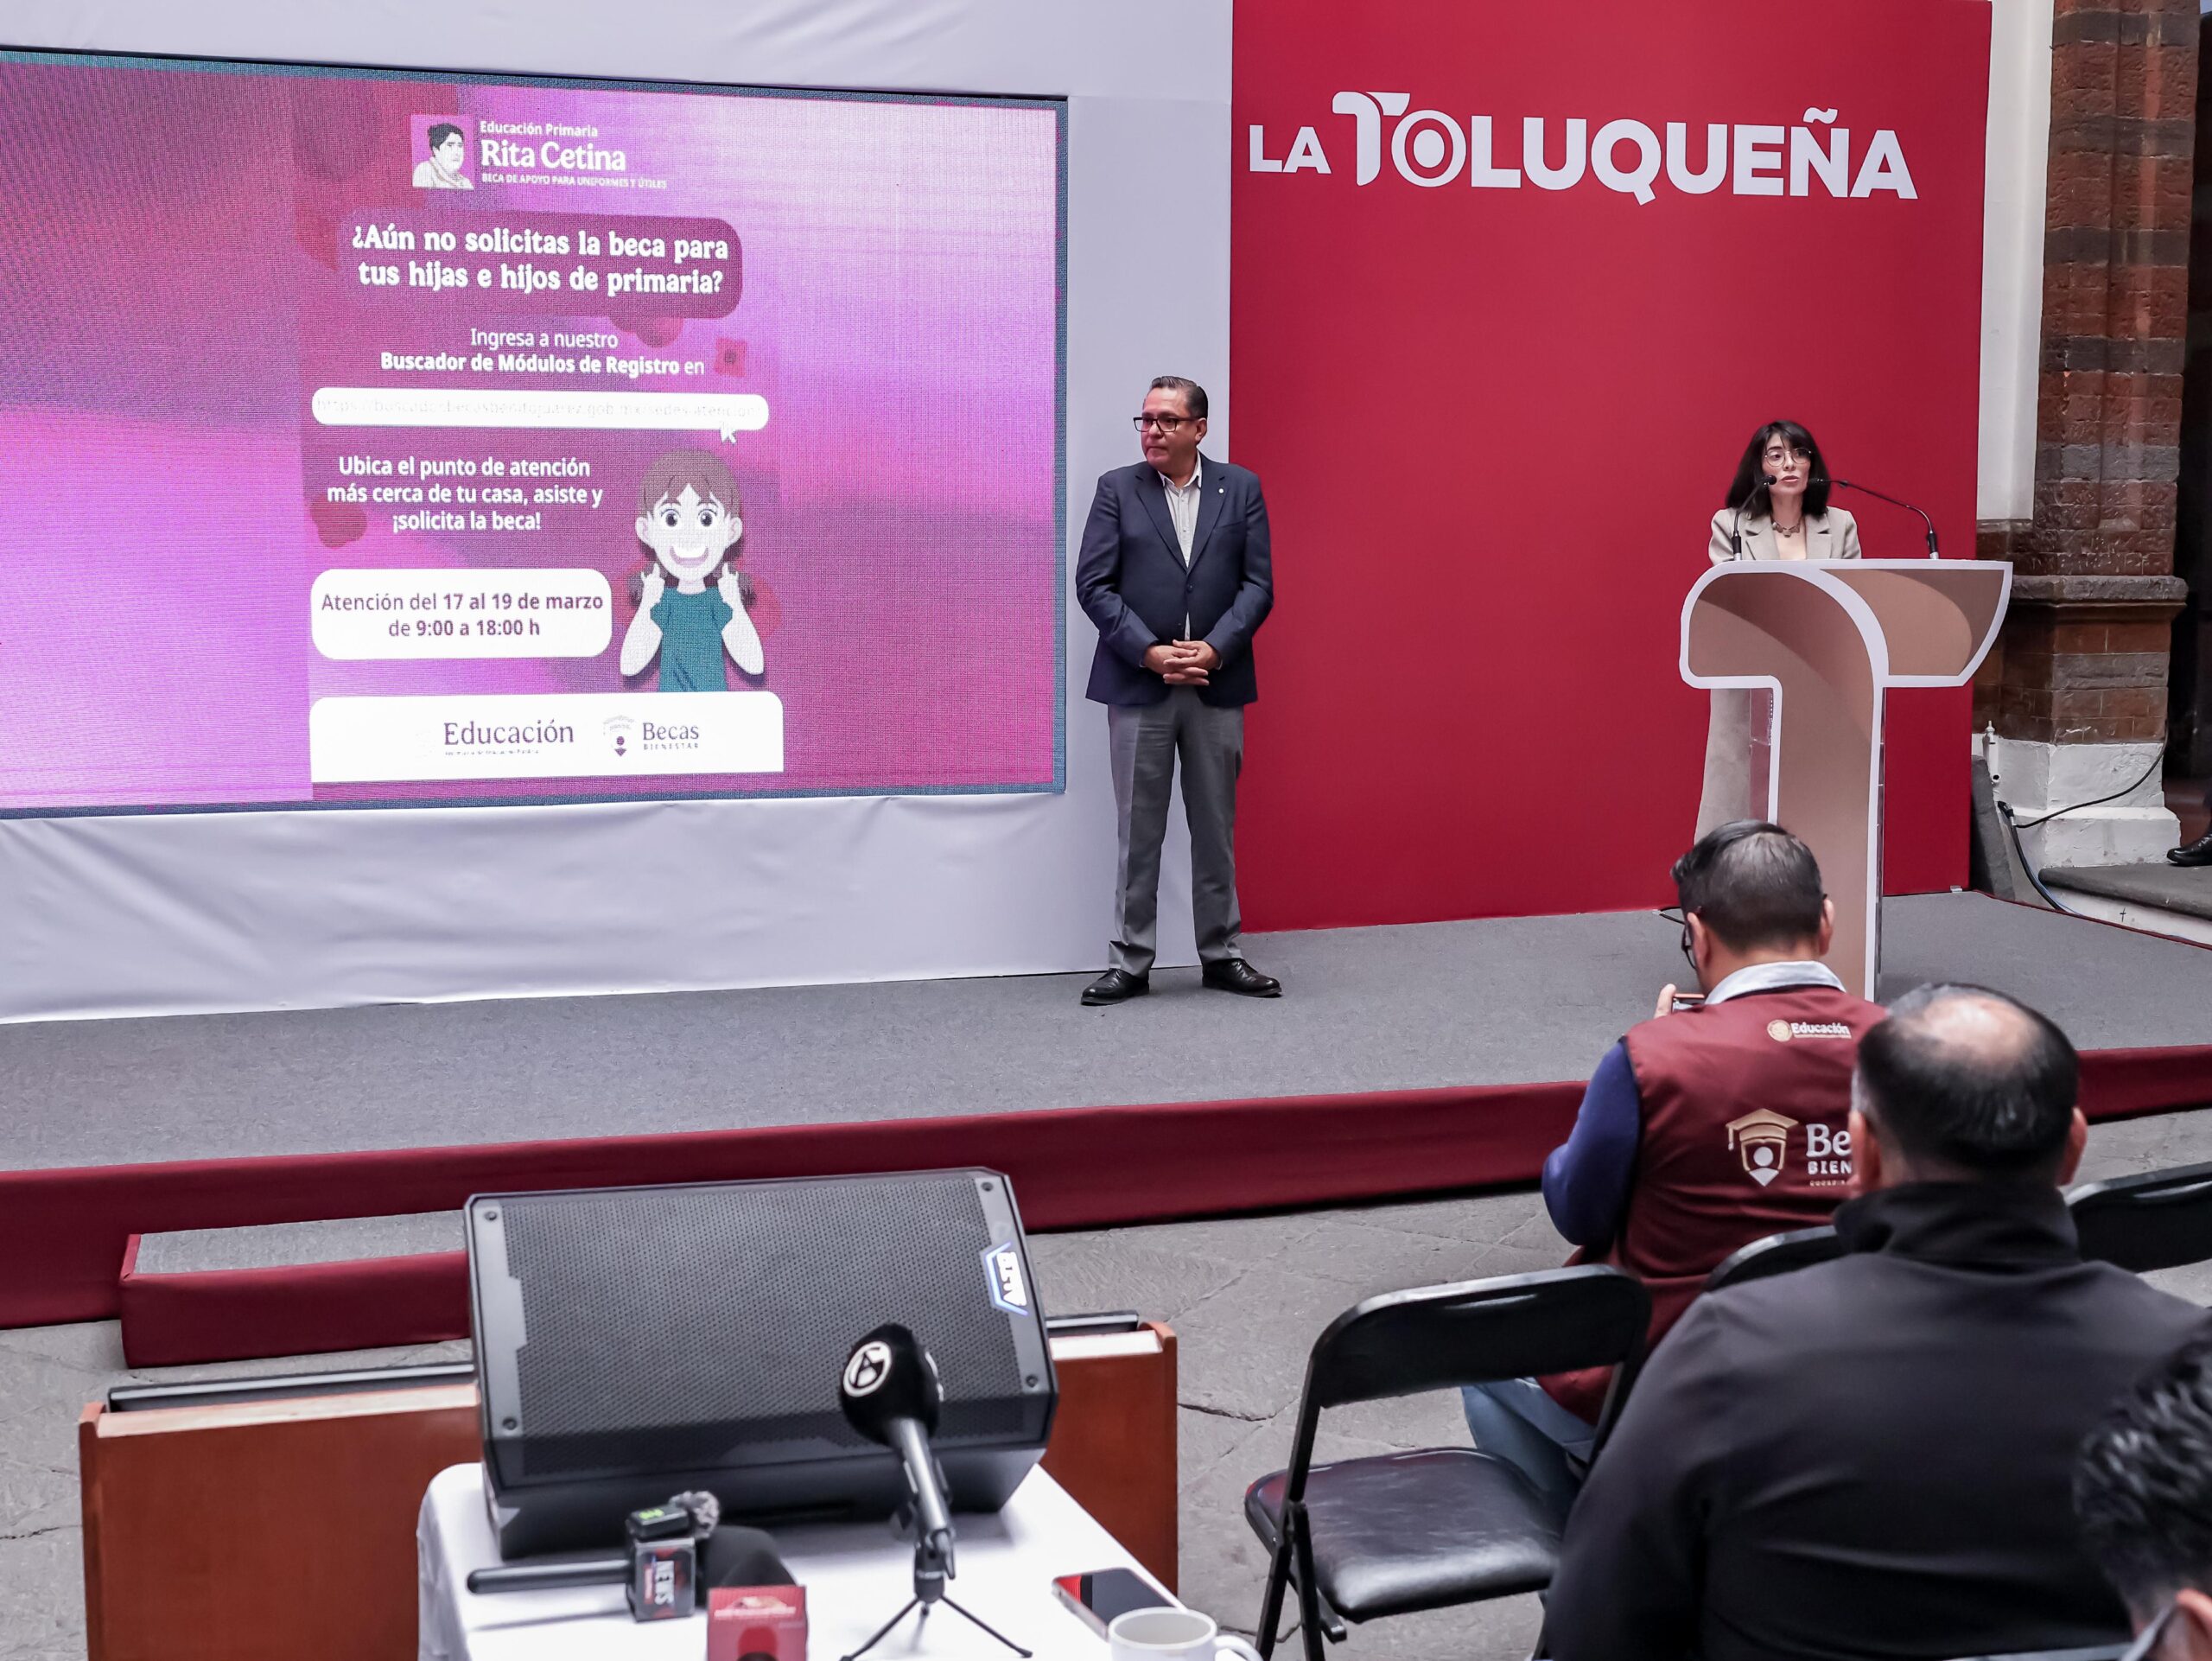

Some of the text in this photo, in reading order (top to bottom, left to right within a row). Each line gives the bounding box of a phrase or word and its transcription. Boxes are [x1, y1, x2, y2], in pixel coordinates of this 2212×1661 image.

[480, 121, 598, 137] Educación Primaria
[481, 139, 626, 170] Rita Cetina
[1249, 90, 1919, 206] LA TOLUQUEÑA
[482, 174, 504, 182] BECA
[519, 175, 549, 184] APOYO
[552, 176, 575, 185] PARA
[578, 176, 628, 187] UNIFORMES
[353, 223, 728, 263] ¿Aún no solicitas la beca para
[359, 264, 722, 296] tus hijas e hijos de primaria?
[471, 328, 618, 349] Ingresa a nuestro
[381, 353, 704, 379] Buscador de Módulos de Registro en
[339, 457, 590, 480] Ubica el punto de atención
[327, 485, 603, 508] más cerca de tu casa, asiste y
[392, 512, 540, 533] ¡solicita la beca!
[321, 593, 603, 611] Atención del 17 al 19 de marzo
[388, 619, 540, 637] de 9:00 a 18:00 h
[444, 718, 574, 745] Educación
[643, 722, 699, 741] Becas
[1790, 1021, 1849, 1034] Educación
